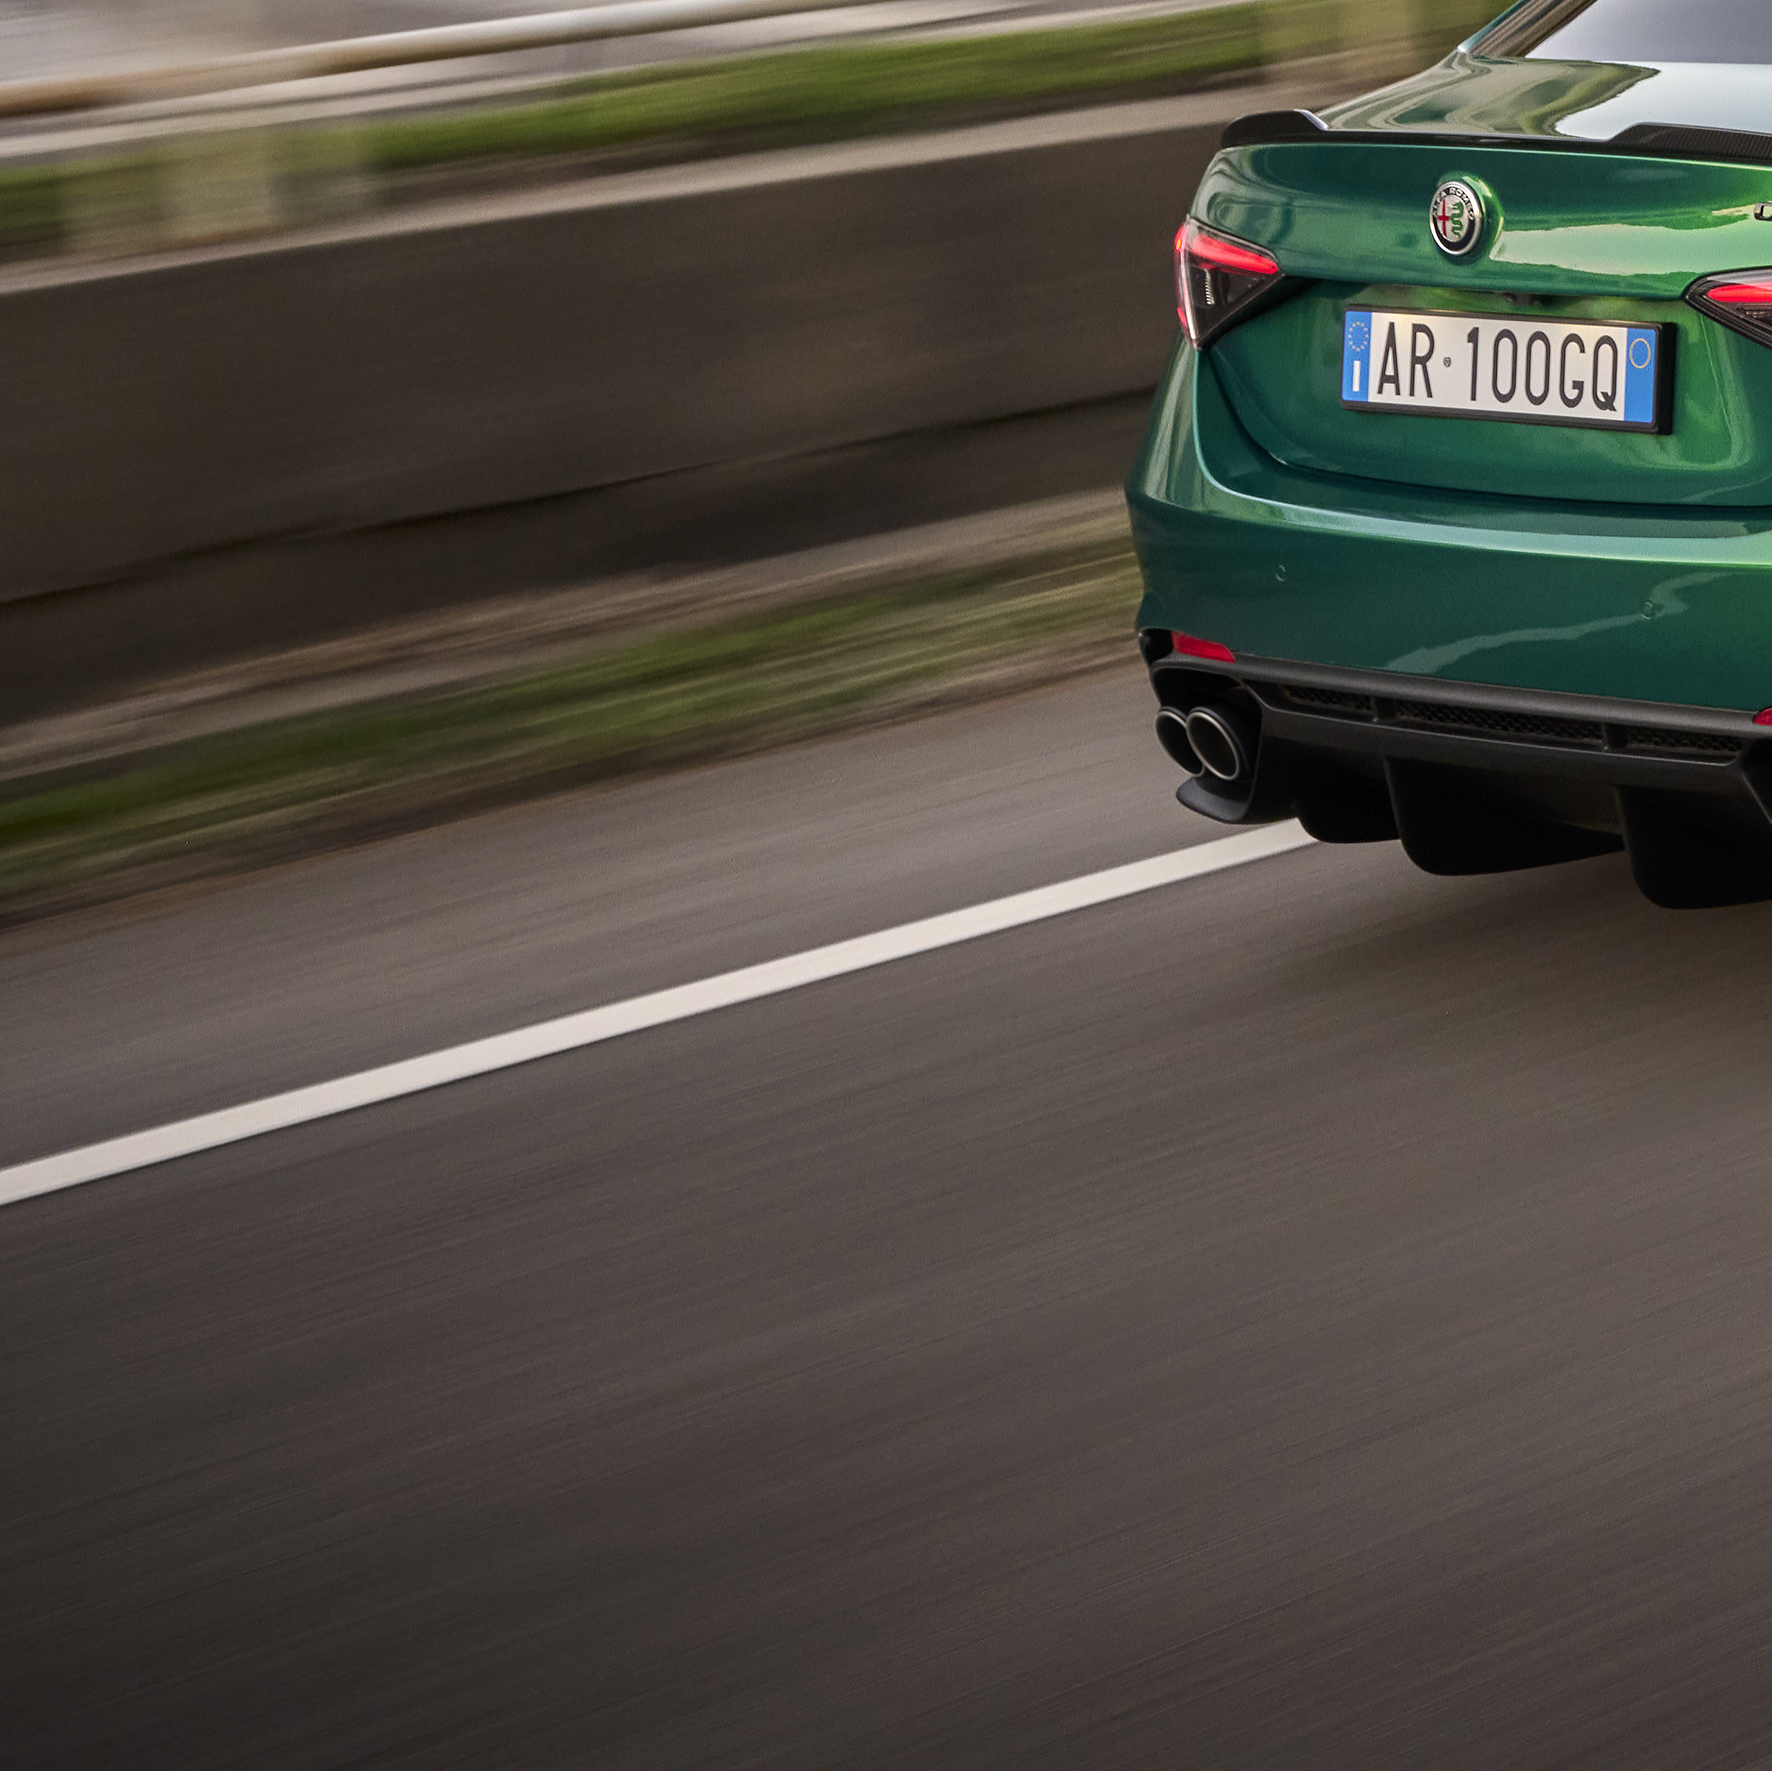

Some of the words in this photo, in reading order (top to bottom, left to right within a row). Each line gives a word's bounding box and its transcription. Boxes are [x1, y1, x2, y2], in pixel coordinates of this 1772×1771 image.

[1449, 188, 1475, 220] ROMEO
[1377, 321, 1435, 398] AR
[1467, 327, 1617, 412] 100GQ
